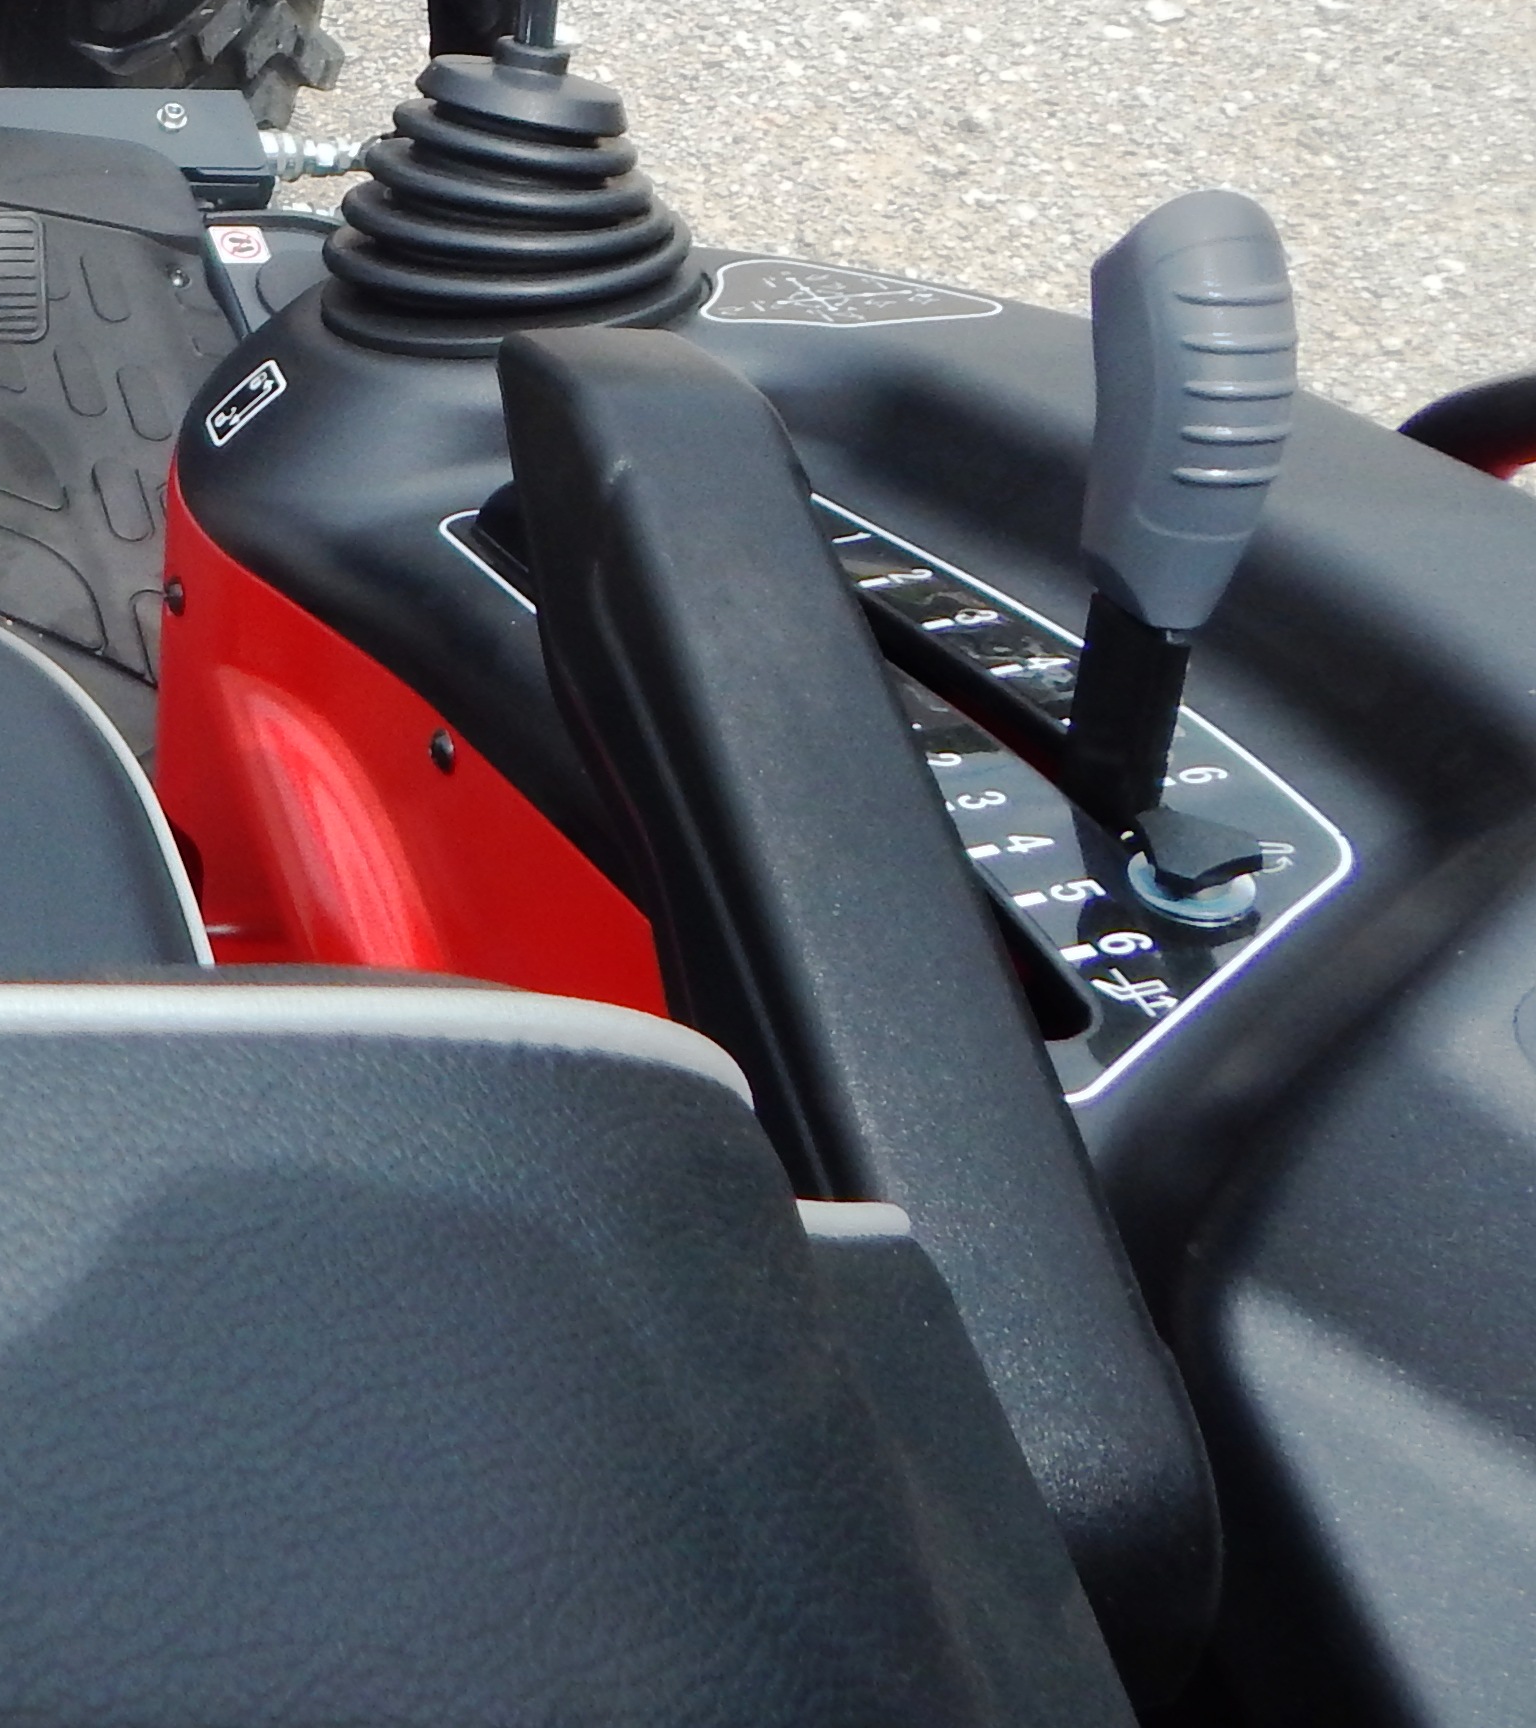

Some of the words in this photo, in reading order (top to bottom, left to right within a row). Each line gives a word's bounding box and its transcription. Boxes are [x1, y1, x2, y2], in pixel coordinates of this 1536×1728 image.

[887, 567, 933, 585] 2
[1178, 766, 1228, 784] 6
[957, 790, 1007, 810] 3
[1006, 834, 1055, 853] 4
[1050, 878, 1107, 902] 5
[1097, 931, 1154, 955] 6
